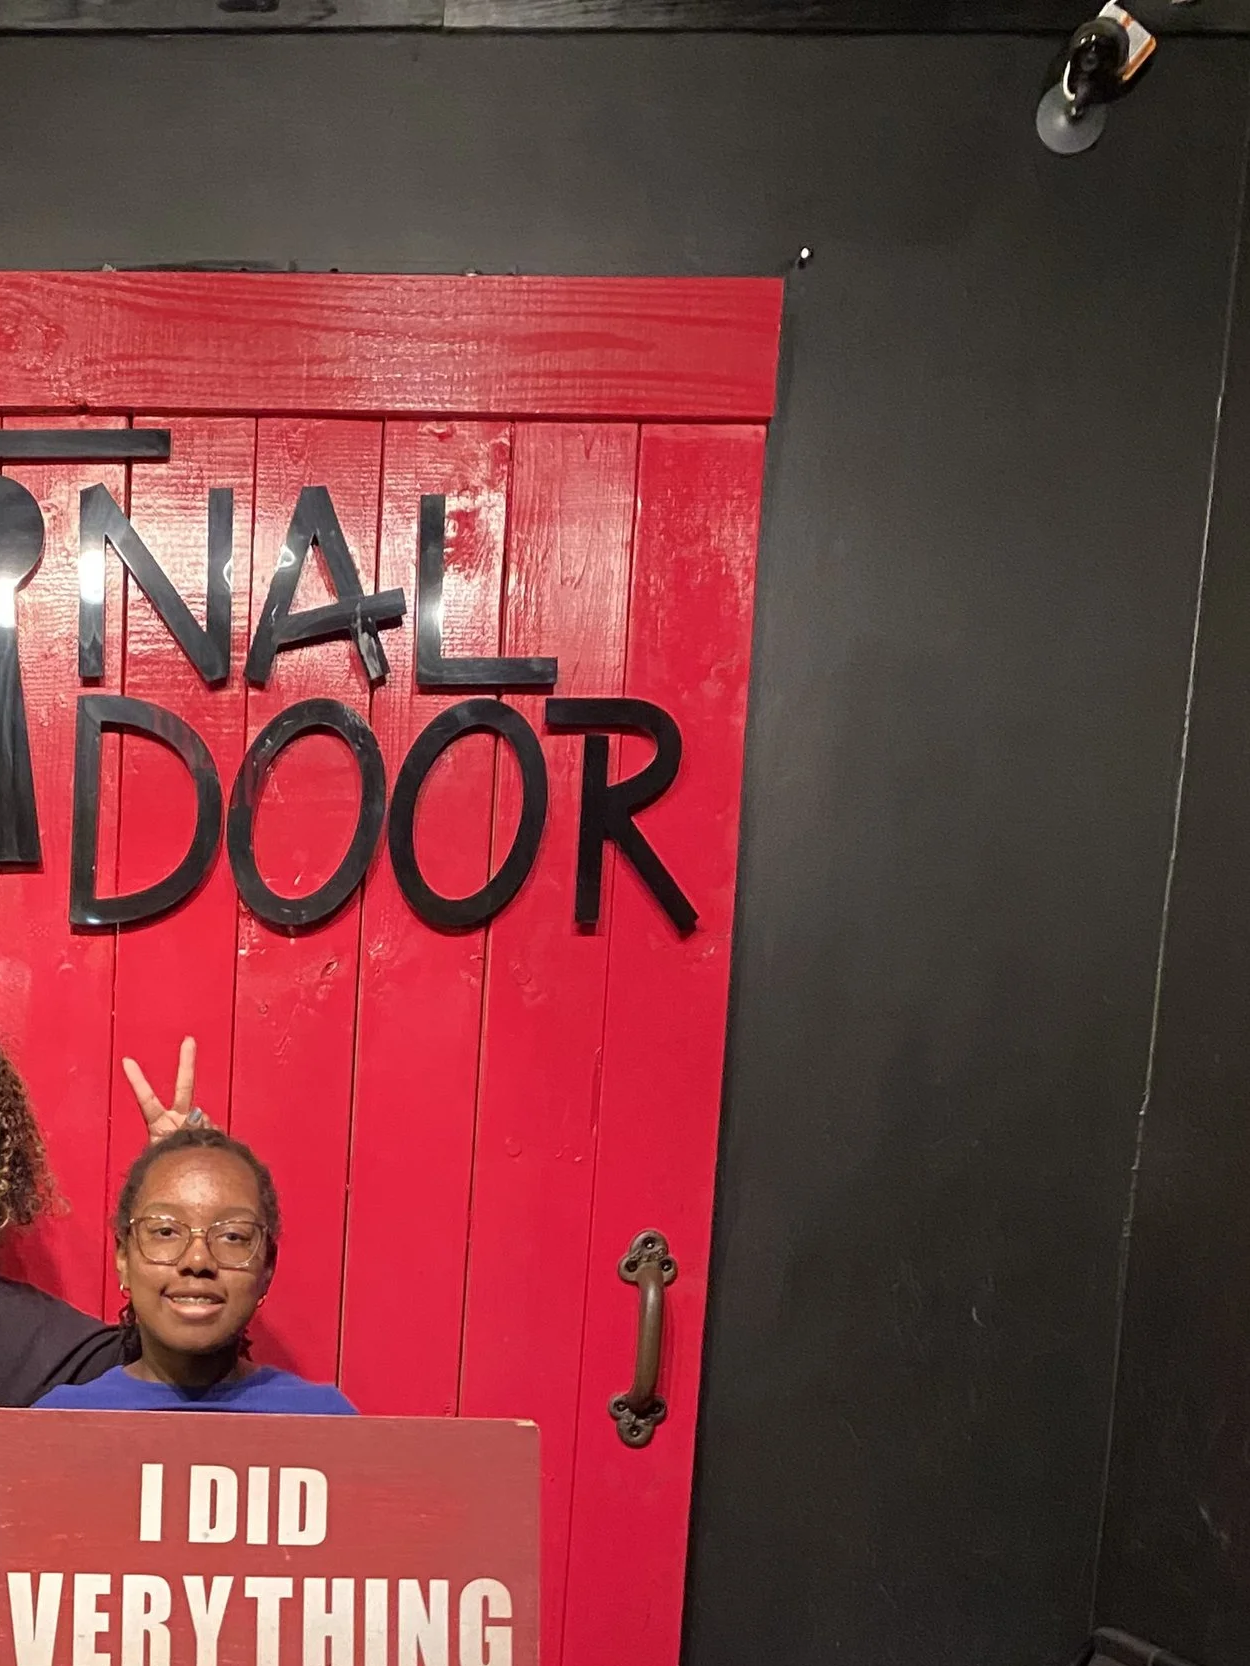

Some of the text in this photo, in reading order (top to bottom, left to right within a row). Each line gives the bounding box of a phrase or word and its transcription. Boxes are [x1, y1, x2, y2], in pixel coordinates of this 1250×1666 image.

[69, 695, 699, 936] DOOR
[139, 1463, 328, 1547] I DID
